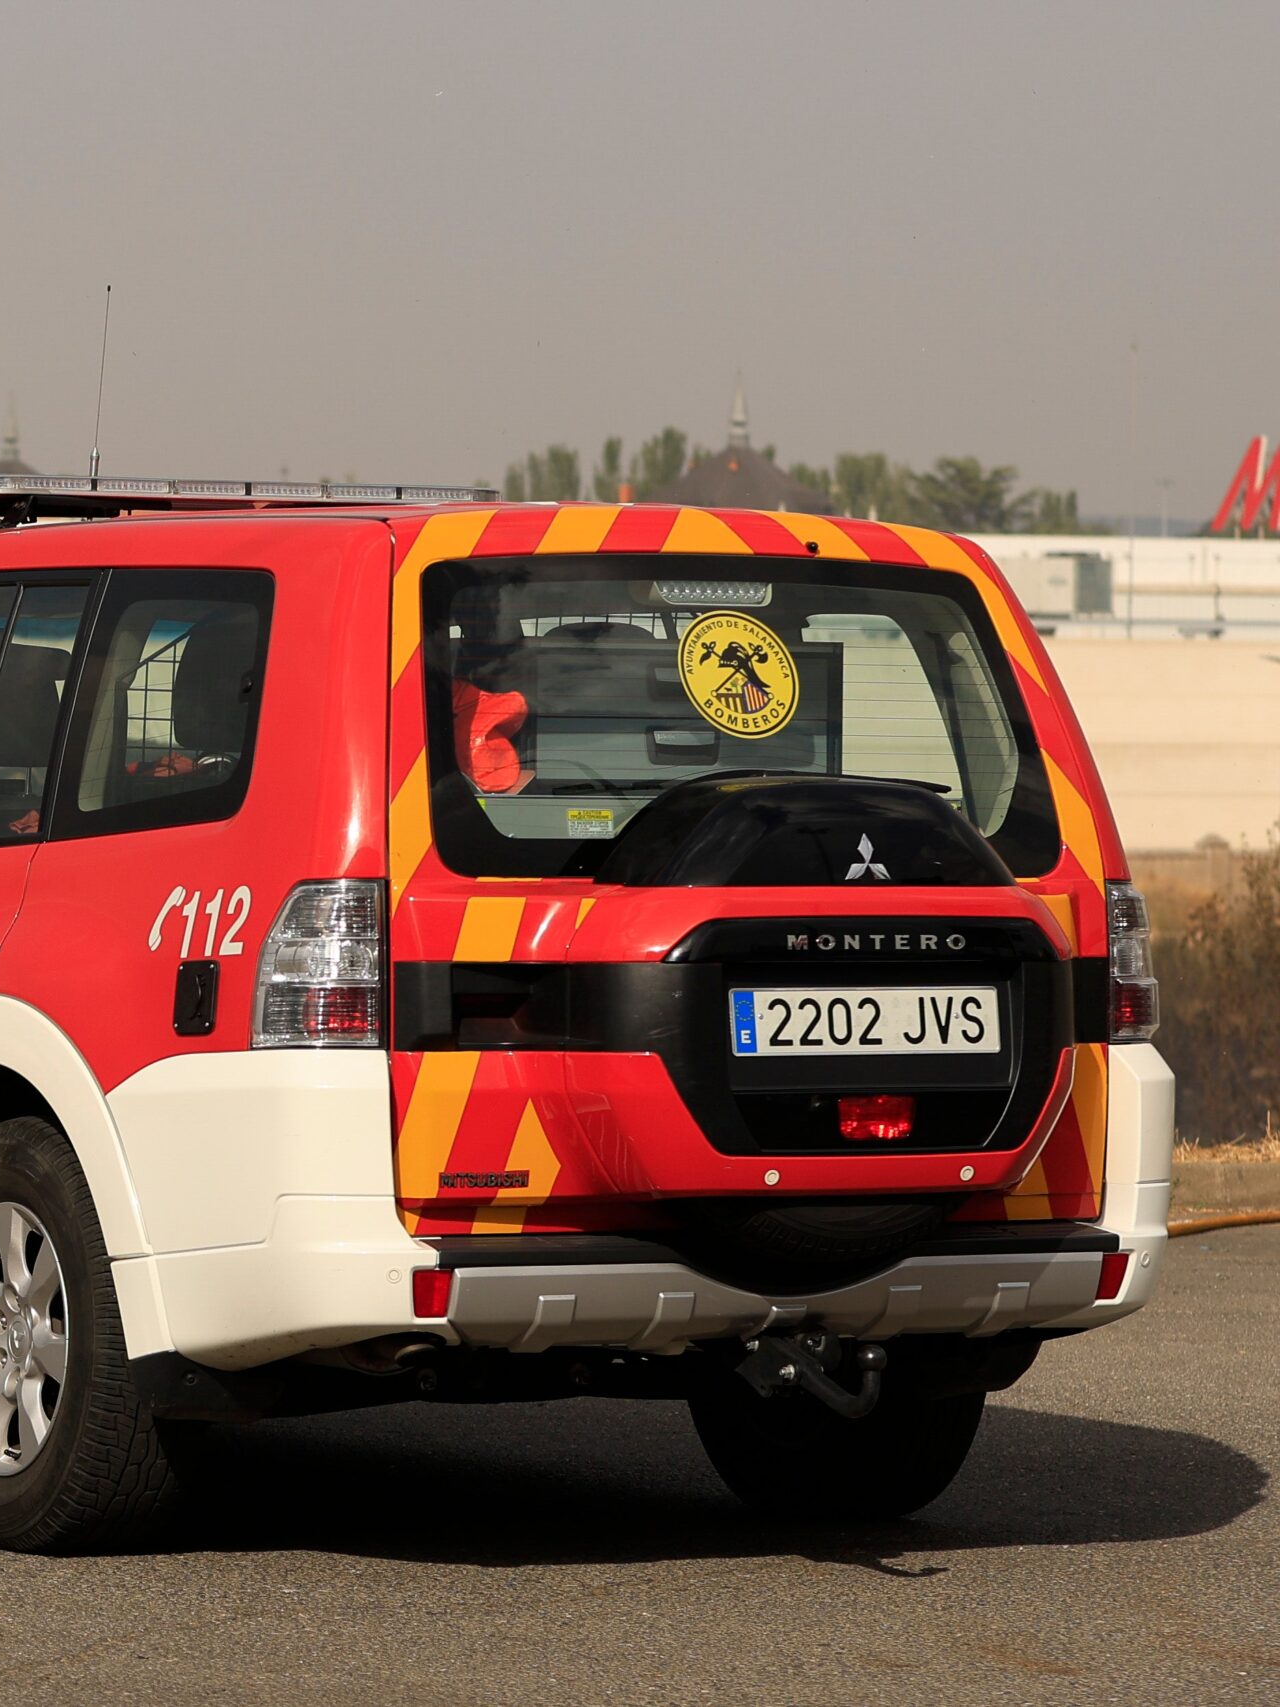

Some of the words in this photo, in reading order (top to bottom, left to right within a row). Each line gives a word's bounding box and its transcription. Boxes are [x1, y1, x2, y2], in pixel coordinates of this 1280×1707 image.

[685, 620, 724, 675] AYUNTAMIENTO
[726, 620, 739, 629] DE
[743, 624, 790, 679] SALAMANCA
[703, 698, 786, 729] BOMBEROS
[180, 885, 252, 958] 112
[787, 934, 966, 950] MONTERO
[740, 1030, 751, 1044] E
[767, 998, 883, 1046] 2202
[903, 996, 985, 1045] JVS
[439, 1171, 529, 1188] MITSUBISHI
